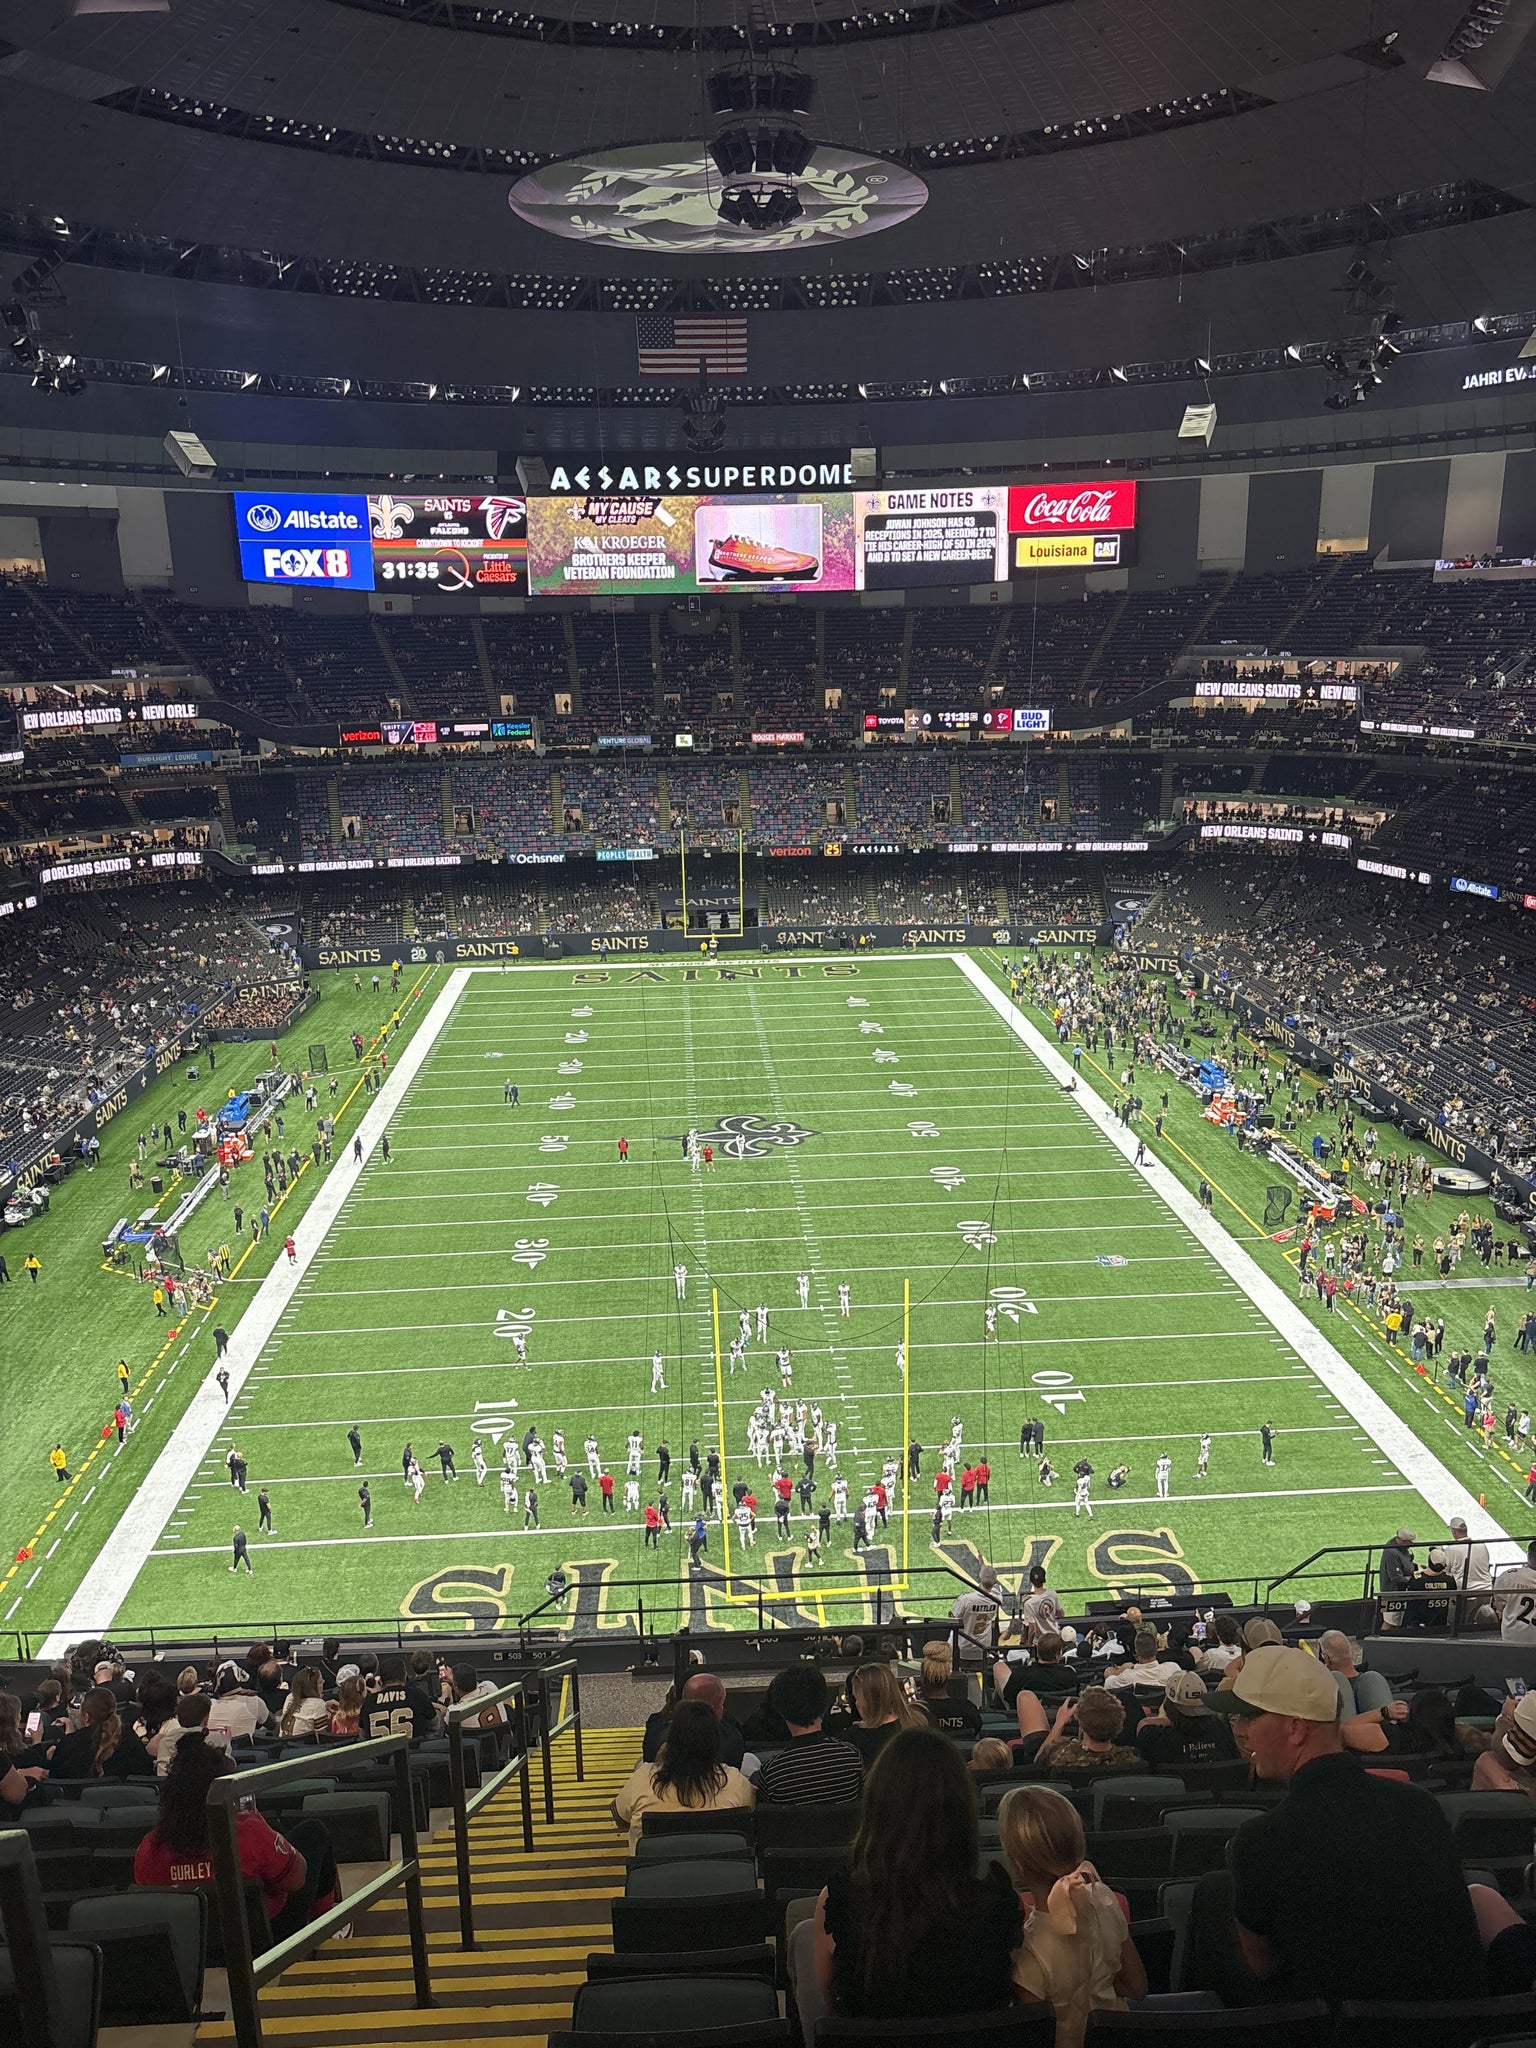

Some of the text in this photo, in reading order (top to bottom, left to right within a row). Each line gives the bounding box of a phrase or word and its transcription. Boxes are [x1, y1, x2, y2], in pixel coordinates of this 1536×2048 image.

[1462, 370, 1502, 390] JAHRI
[550, 464, 857, 491] AESARS SUPERDOME
[424, 499, 471, 512] SAINTS
[888, 492, 974, 510] GAME NOTES
[1024, 490, 1118, 525] Coca-Cola
[588, 501, 654, 516] MY CAUSE
[595, 515, 637, 524] MY CLEATS
[885, 519, 912, 530] JUWAN
[912, 518, 946, 529] JOHNSON
[948, 517, 964, 528] HAS
[430, 527, 469, 535] FALCONS
[865, 530, 912, 541] RECEPTIONS
[912, 529, 922, 540] IN
[945, 528, 979, 539] NEEDING
[986, 527, 996, 538] TO
[602, 536, 666, 549] KROEGER
[864, 541, 877, 552] TIE
[878, 541, 892, 552] HIS
[893, 540, 941, 552] CAREER-HIGH
[943, 539, 954, 550] OF
[867, 552, 884, 563] AND
[891, 551, 901, 562] TO
[902, 551, 916, 562] SET
[923, 550, 940, 561] NEW
[1030, 542, 1118, 558] Louisiana CAT
[484, 561, 512, 573] Little
[572, 553, 666, 567] BROTHERS KEEPER
[382, 562, 439, 579] 31:35
[476, 570, 517, 583] Caesars
[563, 565, 675, 580] VETERAN FOUNDATION
[1196, 682, 1301, 698] NEW ORLEANS SAINTS
[1320, 685, 1342, 699] NEW
[40, 708, 122, 728] ORLEANS SAINTS
[142, 705, 165, 721] NEW
[1021, 712, 1043, 720] BUD
[506, 722, 531, 730] Keesler
[1017, 720, 1047, 729] LIGHT
[342, 731, 380, 741] verizon
[507, 729, 531, 737] Federal
[1201, 825, 1303, 842] NEW ORLEANS SAINTS
[1322, 832, 1341, 847] NEW
[769, 846, 812, 856] verizon
[826, 845, 839, 854] 25
[852, 845, 899, 854] CAESARS
[953, 844, 979, 852] SAINTS
[991, 843, 1062, 852] NEW ORLEANS SAINTS
[1075, 842, 1148, 851] NEW ORLEANS SAINTS
[152, 853, 175, 867] NEW
[388, 856, 461, 867] NEW ORLEANS SAINTS
[476, 852, 503, 861] SAINTS
[516, 853, 564, 864] Ochsner
[597, 850, 626, 859] PEOPLES
[52, 857, 131, 882] ORLEANS SAINTS
[258, 865, 284, 874] SAINTS
[299, 860, 374, 872] NEW ORLEANS SAINTS
[1383, 864, 1406, 879] SAINTS
[675, 897, 744, 906] SAINTS
[591, 935, 648, 951] SAINTS
[908, 930, 966, 943] SAINTS
[1037, 930, 1096, 943] SAINTS
[456, 942, 517, 957] SAINTS
[319, 949, 381, 965] SAINTS
[572, 964, 860, 985] SAINTS
[239, 981, 301, 1001] SAINTS
[1264, 1016, 1296, 1048] SAINTS
[156, 1039, 181, 1074] SAINTS
[95, 1088, 128, 1129] SAINTS
[1418, 1117, 1466, 1163] SAINTS
[956, 1220, 998, 1244] 30
[511, 1238, 549, 1263] 30
[989, 1286, 1039, 1315] 20
[493, 1307, 536, 1338] 20
[1031, 1370, 1087, 1403] 10
[470, 1398, 519, 1434] 10
[972, 1604, 997, 1612] RATTLER
[1388, 1599, 1448, 1611] 501 559
[508, 1651, 547, 1660] 503 501
[377, 1690, 406, 1704] DAVIS
[369, 1707, 414, 1739] 56
[938, 1717, 963, 1729] INTS
[170, 1862, 212, 1882] GURLEY
